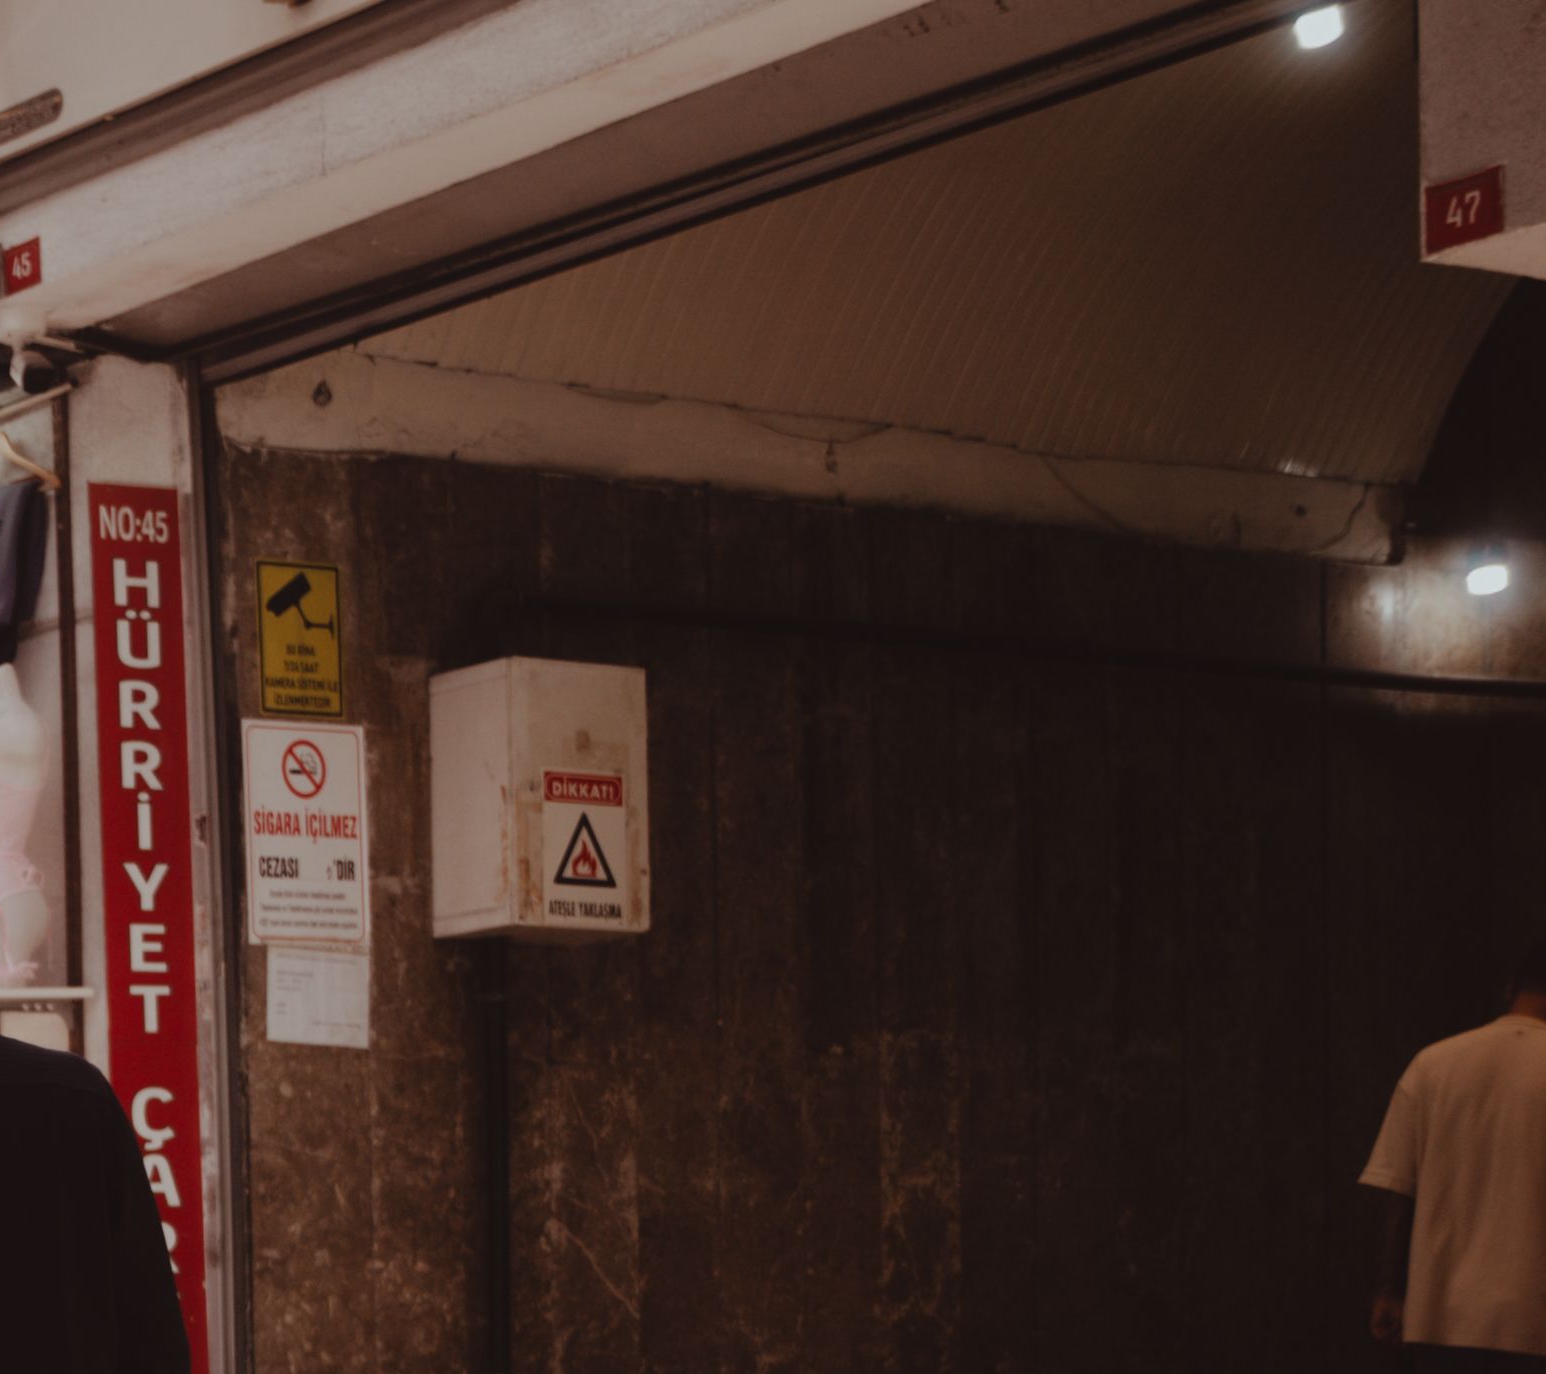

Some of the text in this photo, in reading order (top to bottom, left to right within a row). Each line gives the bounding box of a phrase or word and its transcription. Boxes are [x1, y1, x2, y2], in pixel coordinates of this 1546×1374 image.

[1445, 189, 1481, 229] 47
[11, 250, 32, 280] 45
[98, 505, 169, 543] NO:45
[112, 559, 170, 1037] HÜRRİYET
[253, 805, 358, 844] SİGARA İÇİLMEZ
[259, 856, 299, 880] CEZASI
[548, 899, 622, 920] ATEŞLE YAKLAŞMA
